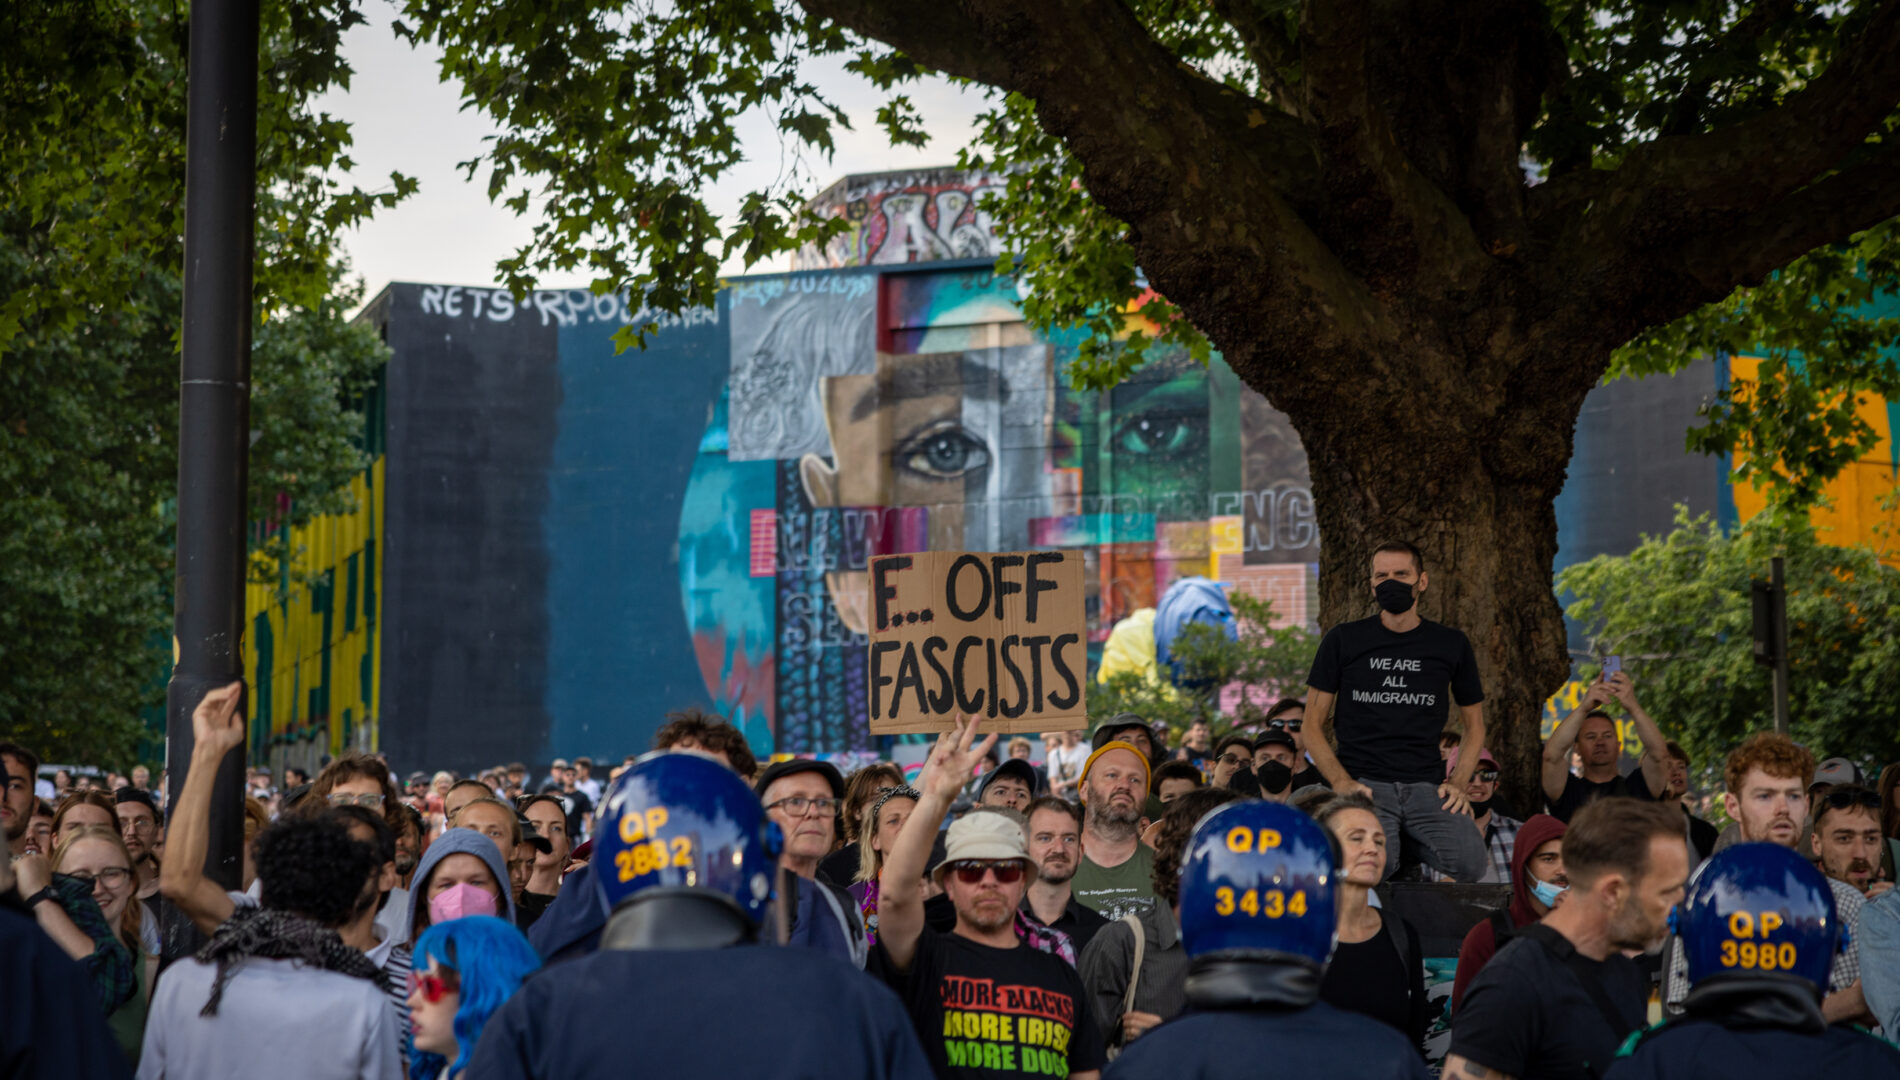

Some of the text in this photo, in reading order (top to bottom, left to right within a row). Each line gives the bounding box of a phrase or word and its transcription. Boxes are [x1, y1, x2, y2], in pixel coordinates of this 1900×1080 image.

[872, 552, 1065, 633] F... OFF
[870, 633, 1080, 720] FASCISTS
[1369, 657, 1422, 672] WE ARE
[1382, 675, 1408, 688] ALL
[1352, 689, 1436, 706] IMMIGRANTS
[618, 806, 669, 844] QP
[1226, 826, 1282, 855] QP
[1215, 886, 1308, 918] 3434
[1728, 910, 1783, 939] QP
[1720, 939, 1797, 970] 3980
[943, 978, 1073, 1023] MORE BLACKS
[943, 1009, 1014, 1041] MORE
[944, 1039, 1017, 1070] MORE
